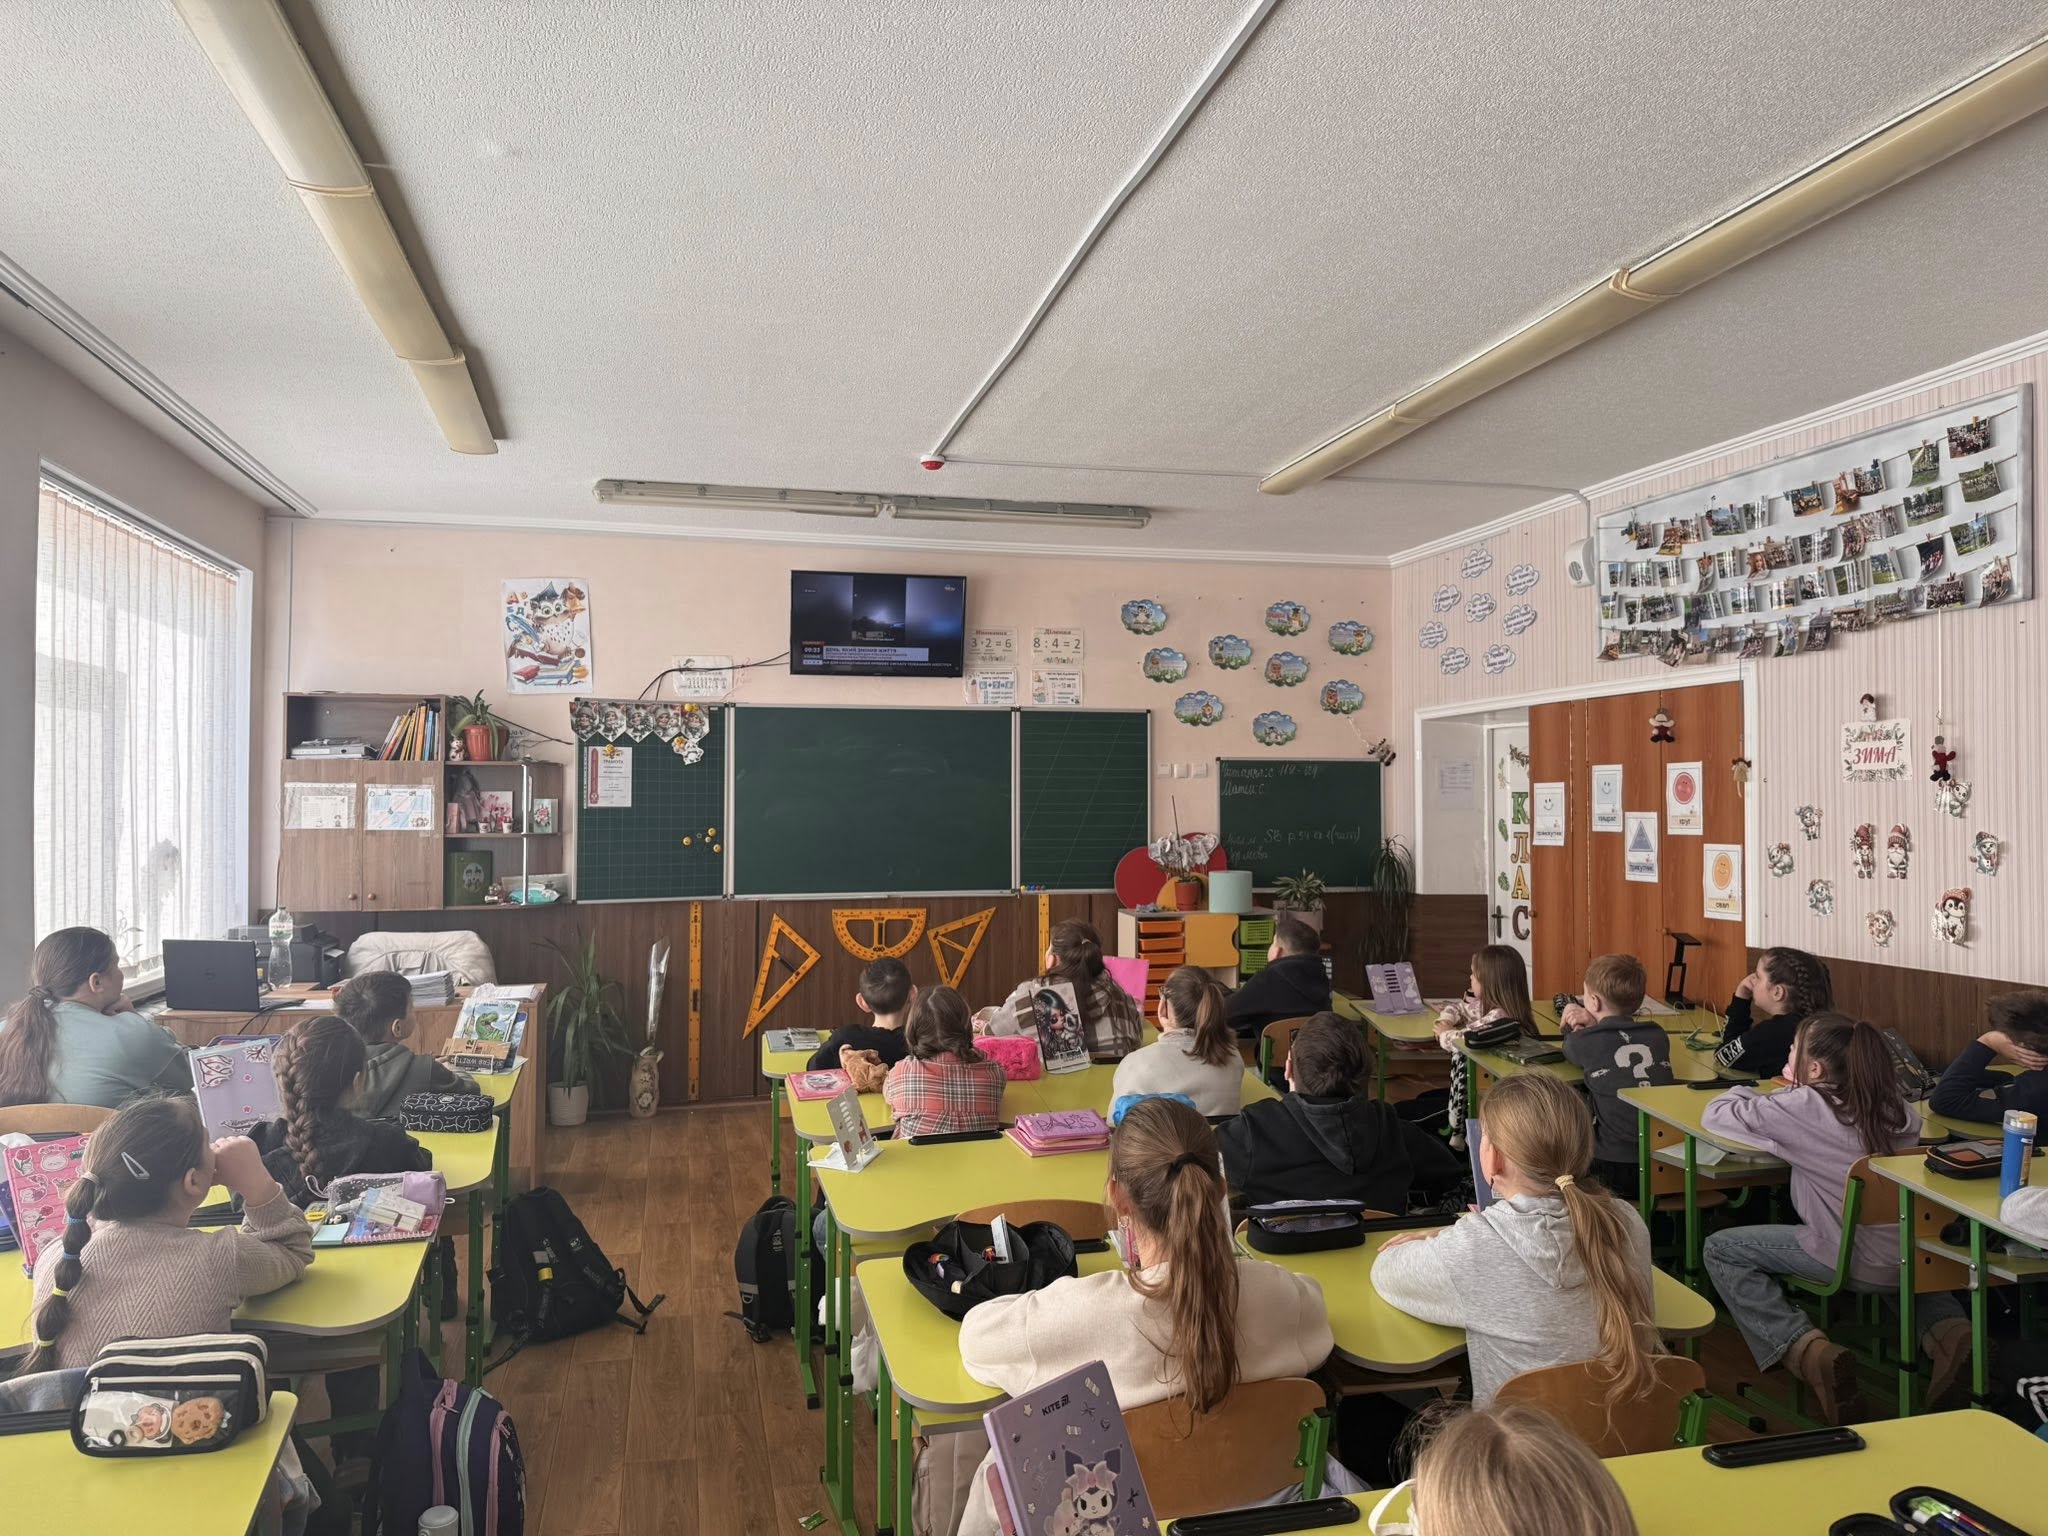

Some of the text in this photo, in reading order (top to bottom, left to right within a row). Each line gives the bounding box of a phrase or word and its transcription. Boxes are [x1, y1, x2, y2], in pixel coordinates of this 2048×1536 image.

[971, 638, 977, 648] 3
[986, 638, 992, 648] 2
[1005, 638, 1011, 648] 6
[1033, 637, 1040, 648] 8
[1052, 638, 1058, 648] 4
[1074, 638, 1080, 649] 2
[1852, 745, 1897, 765] ЗИМА
[1511, 791, 1531, 941] КЛАС
[1036, 1114, 1096, 1131] PARIS
[1041, 1401, 1061, 1416] KITE
